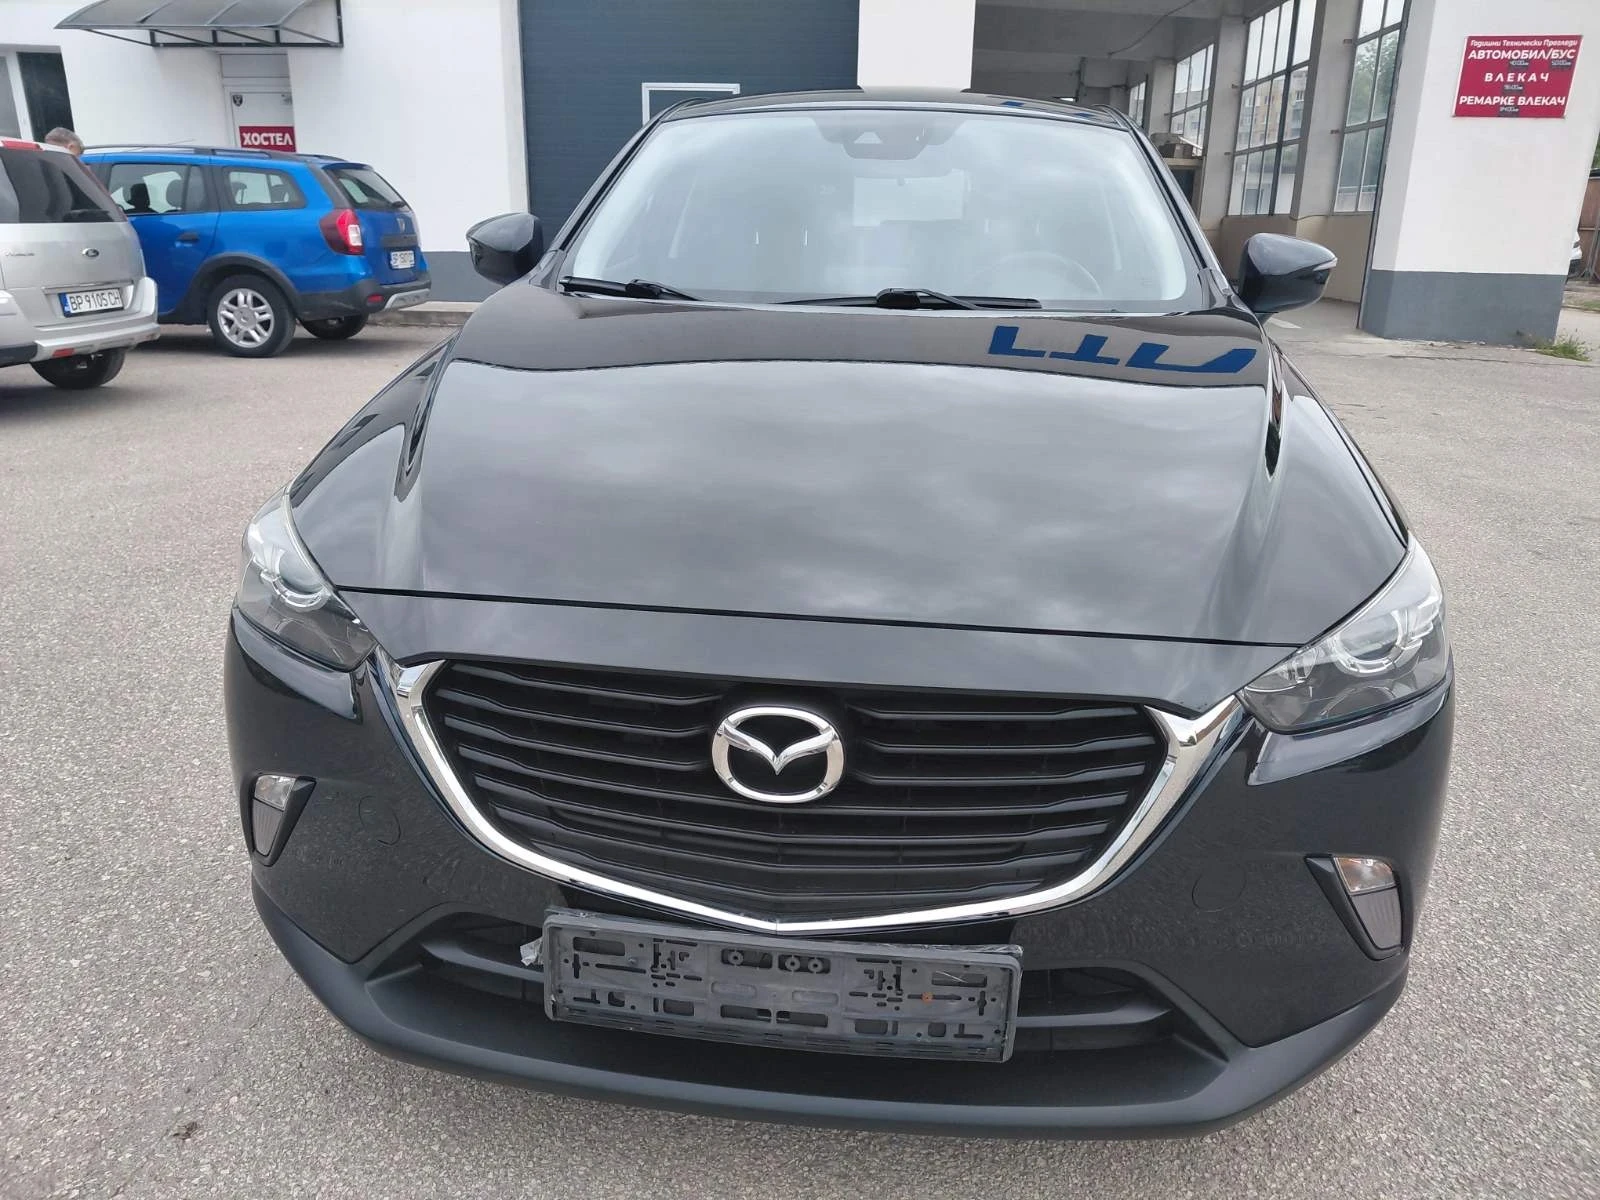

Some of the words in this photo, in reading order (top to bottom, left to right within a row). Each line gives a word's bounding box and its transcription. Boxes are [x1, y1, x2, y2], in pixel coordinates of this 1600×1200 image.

[1468, 49, 1576, 60] АВТОМОБИЛ/БУС
[1484, 72, 1549, 82] ВЛЕКАЧ
[1459, 96, 1515, 105] РЕМАРКЕ
[1517, 96, 1565, 106] ВЛЕКАЧ
[242, 132, 293, 146] ХОСТЕЛ
[69, 295, 83, 311] BP
[84, 292, 108, 308] 9105
